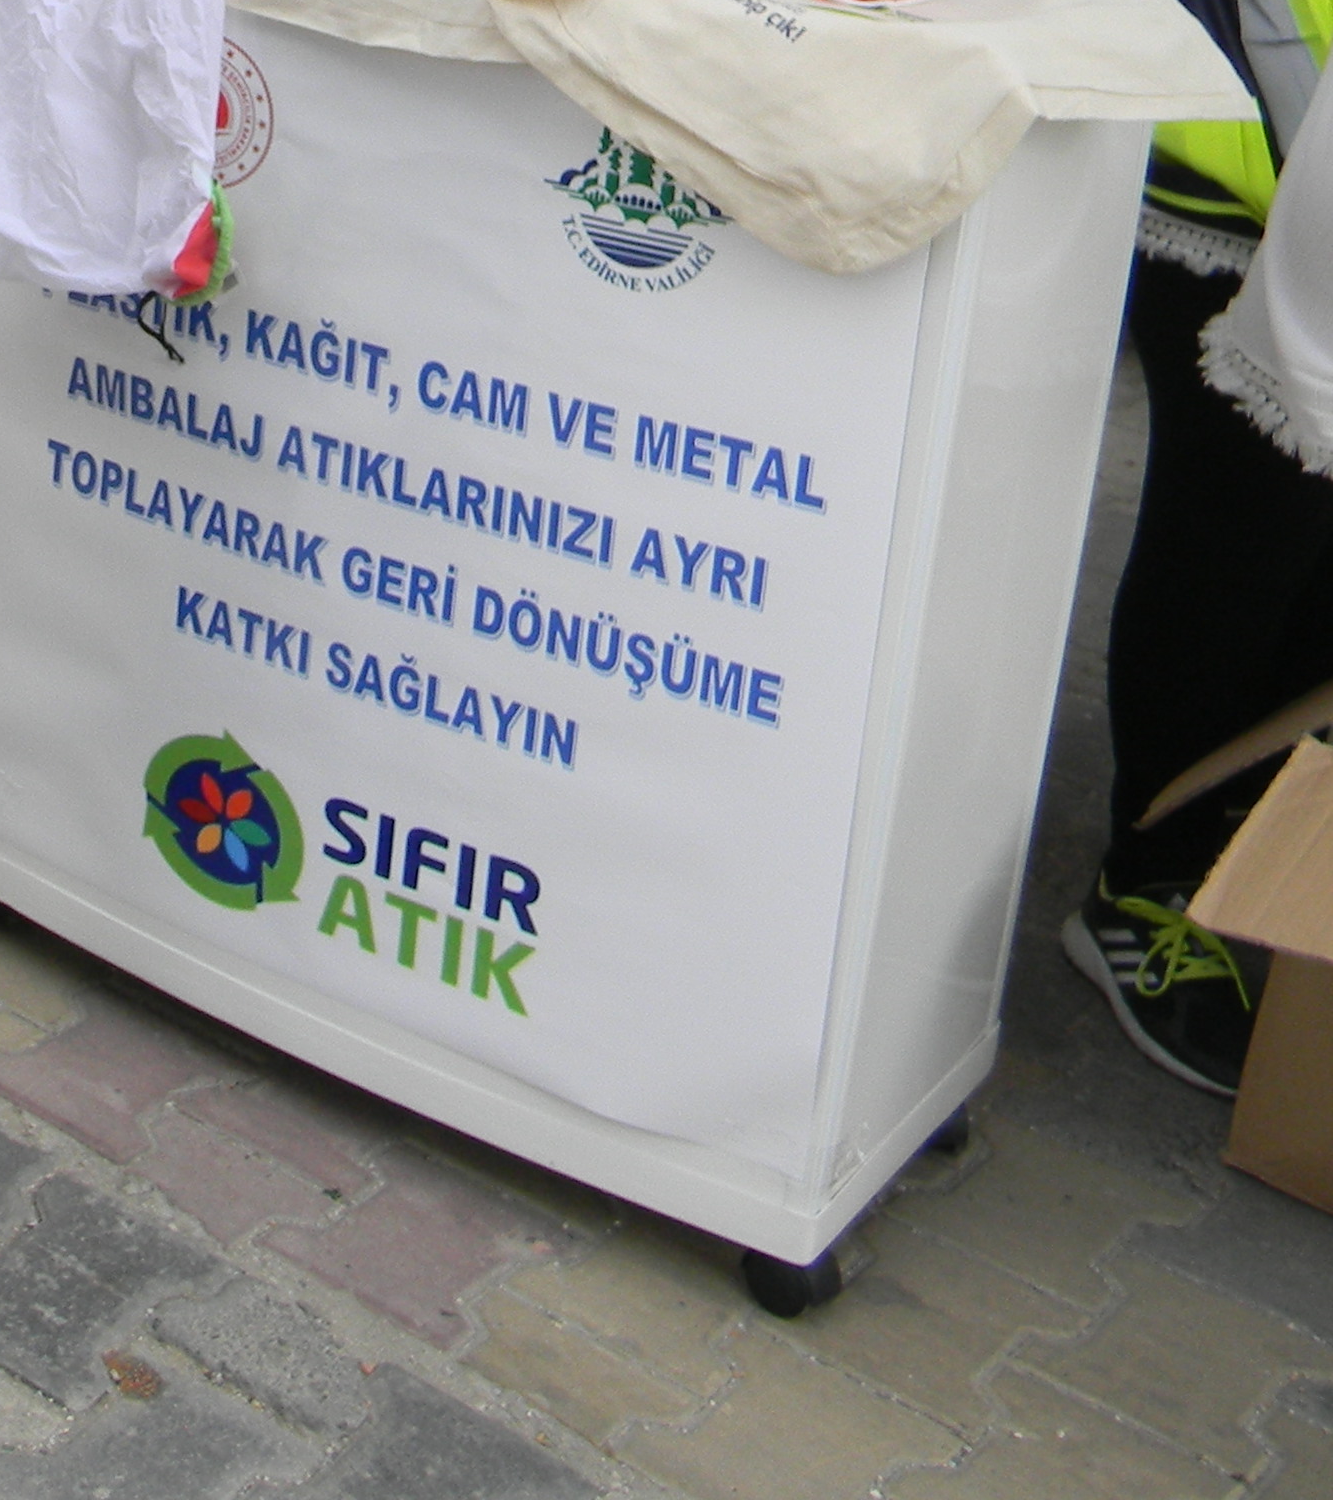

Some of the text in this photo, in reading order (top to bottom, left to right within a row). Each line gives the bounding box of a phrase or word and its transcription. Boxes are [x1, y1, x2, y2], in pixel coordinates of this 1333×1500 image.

[578, 246, 642, 293] EDİRNE
[67, 356, 769, 612] AMBALAJ ATIKLARINIZI AYRI
[245, 308, 402, 411] KAĞIT,
[417, 361, 530, 437] CAM
[548, 391, 618, 459] VE
[633, 414, 826, 514] METAL
[47, 439, 784, 729] TOPLAYARAK GERİ DÖNÜŞÜME
[175, 585, 579, 772] KATKI SAĞLAYIN
[316, 874, 537, 1018] ATIK
[322, 797, 541, 937] SIFIR
